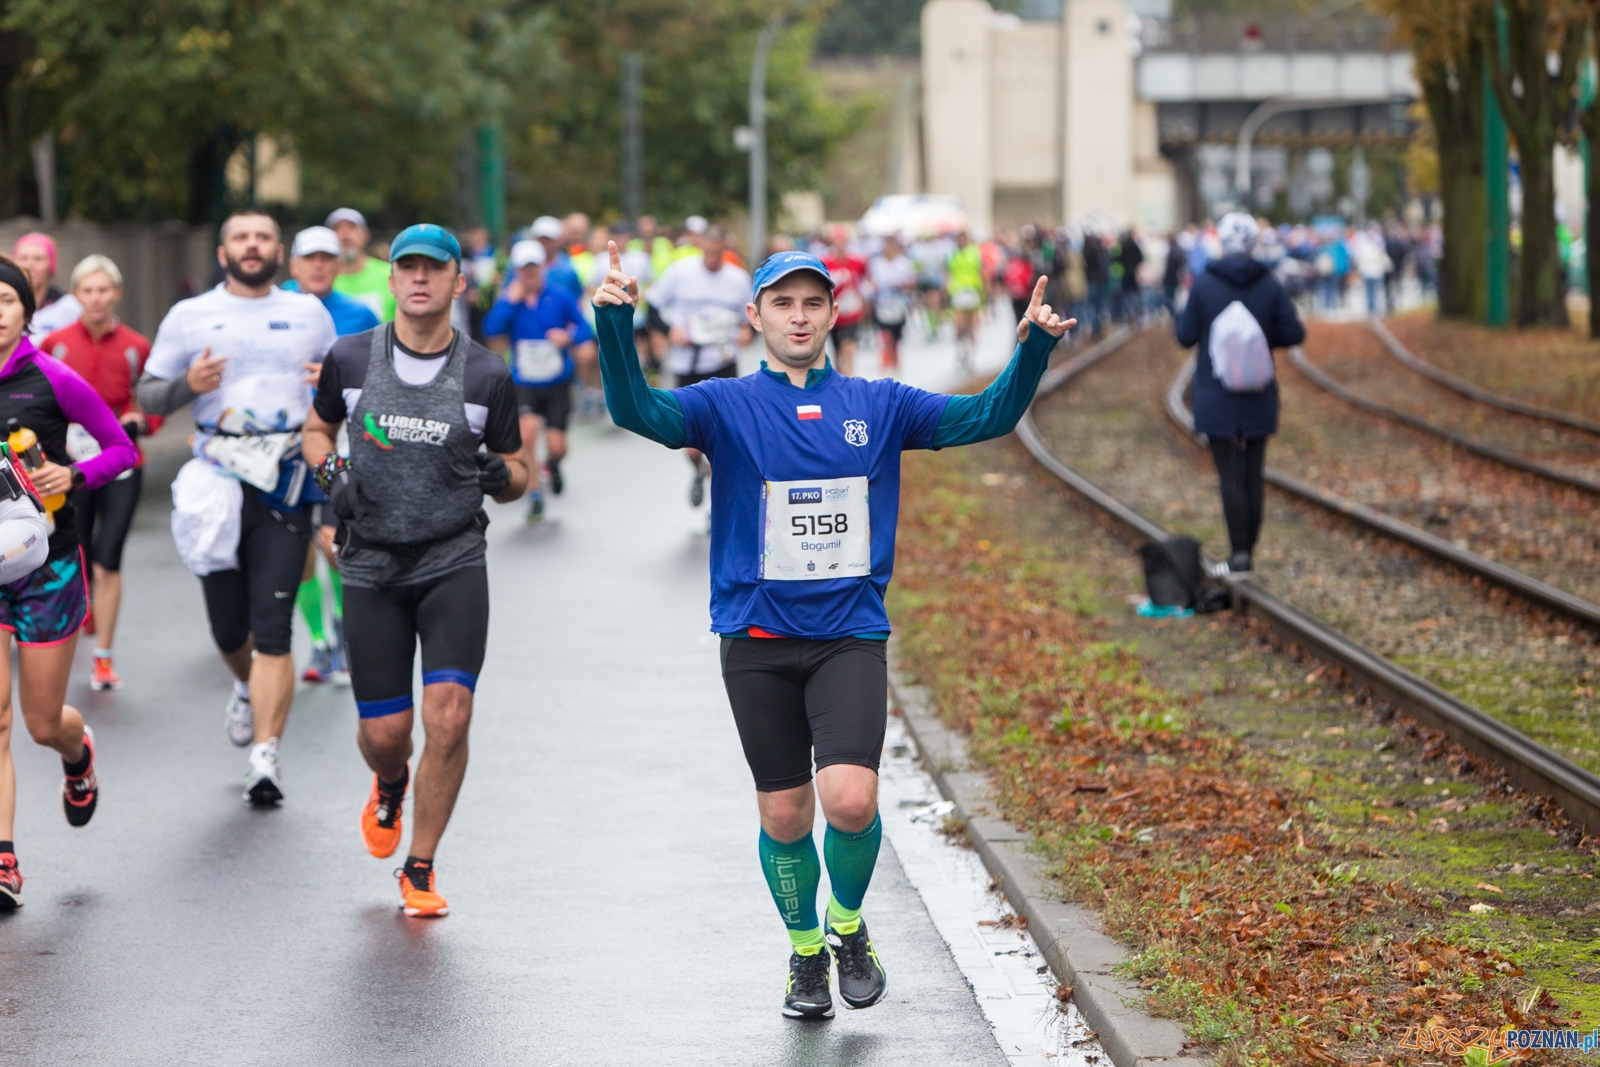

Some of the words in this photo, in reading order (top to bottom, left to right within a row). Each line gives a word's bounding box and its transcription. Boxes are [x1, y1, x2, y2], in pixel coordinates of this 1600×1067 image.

[379, 414, 451, 435] LUBELSKI
[387, 426, 448, 446] BIEGACZ
[802, 491, 820, 500] PKO
[791, 513, 849, 536] 5158
[801, 540, 842, 552] Bogumił
